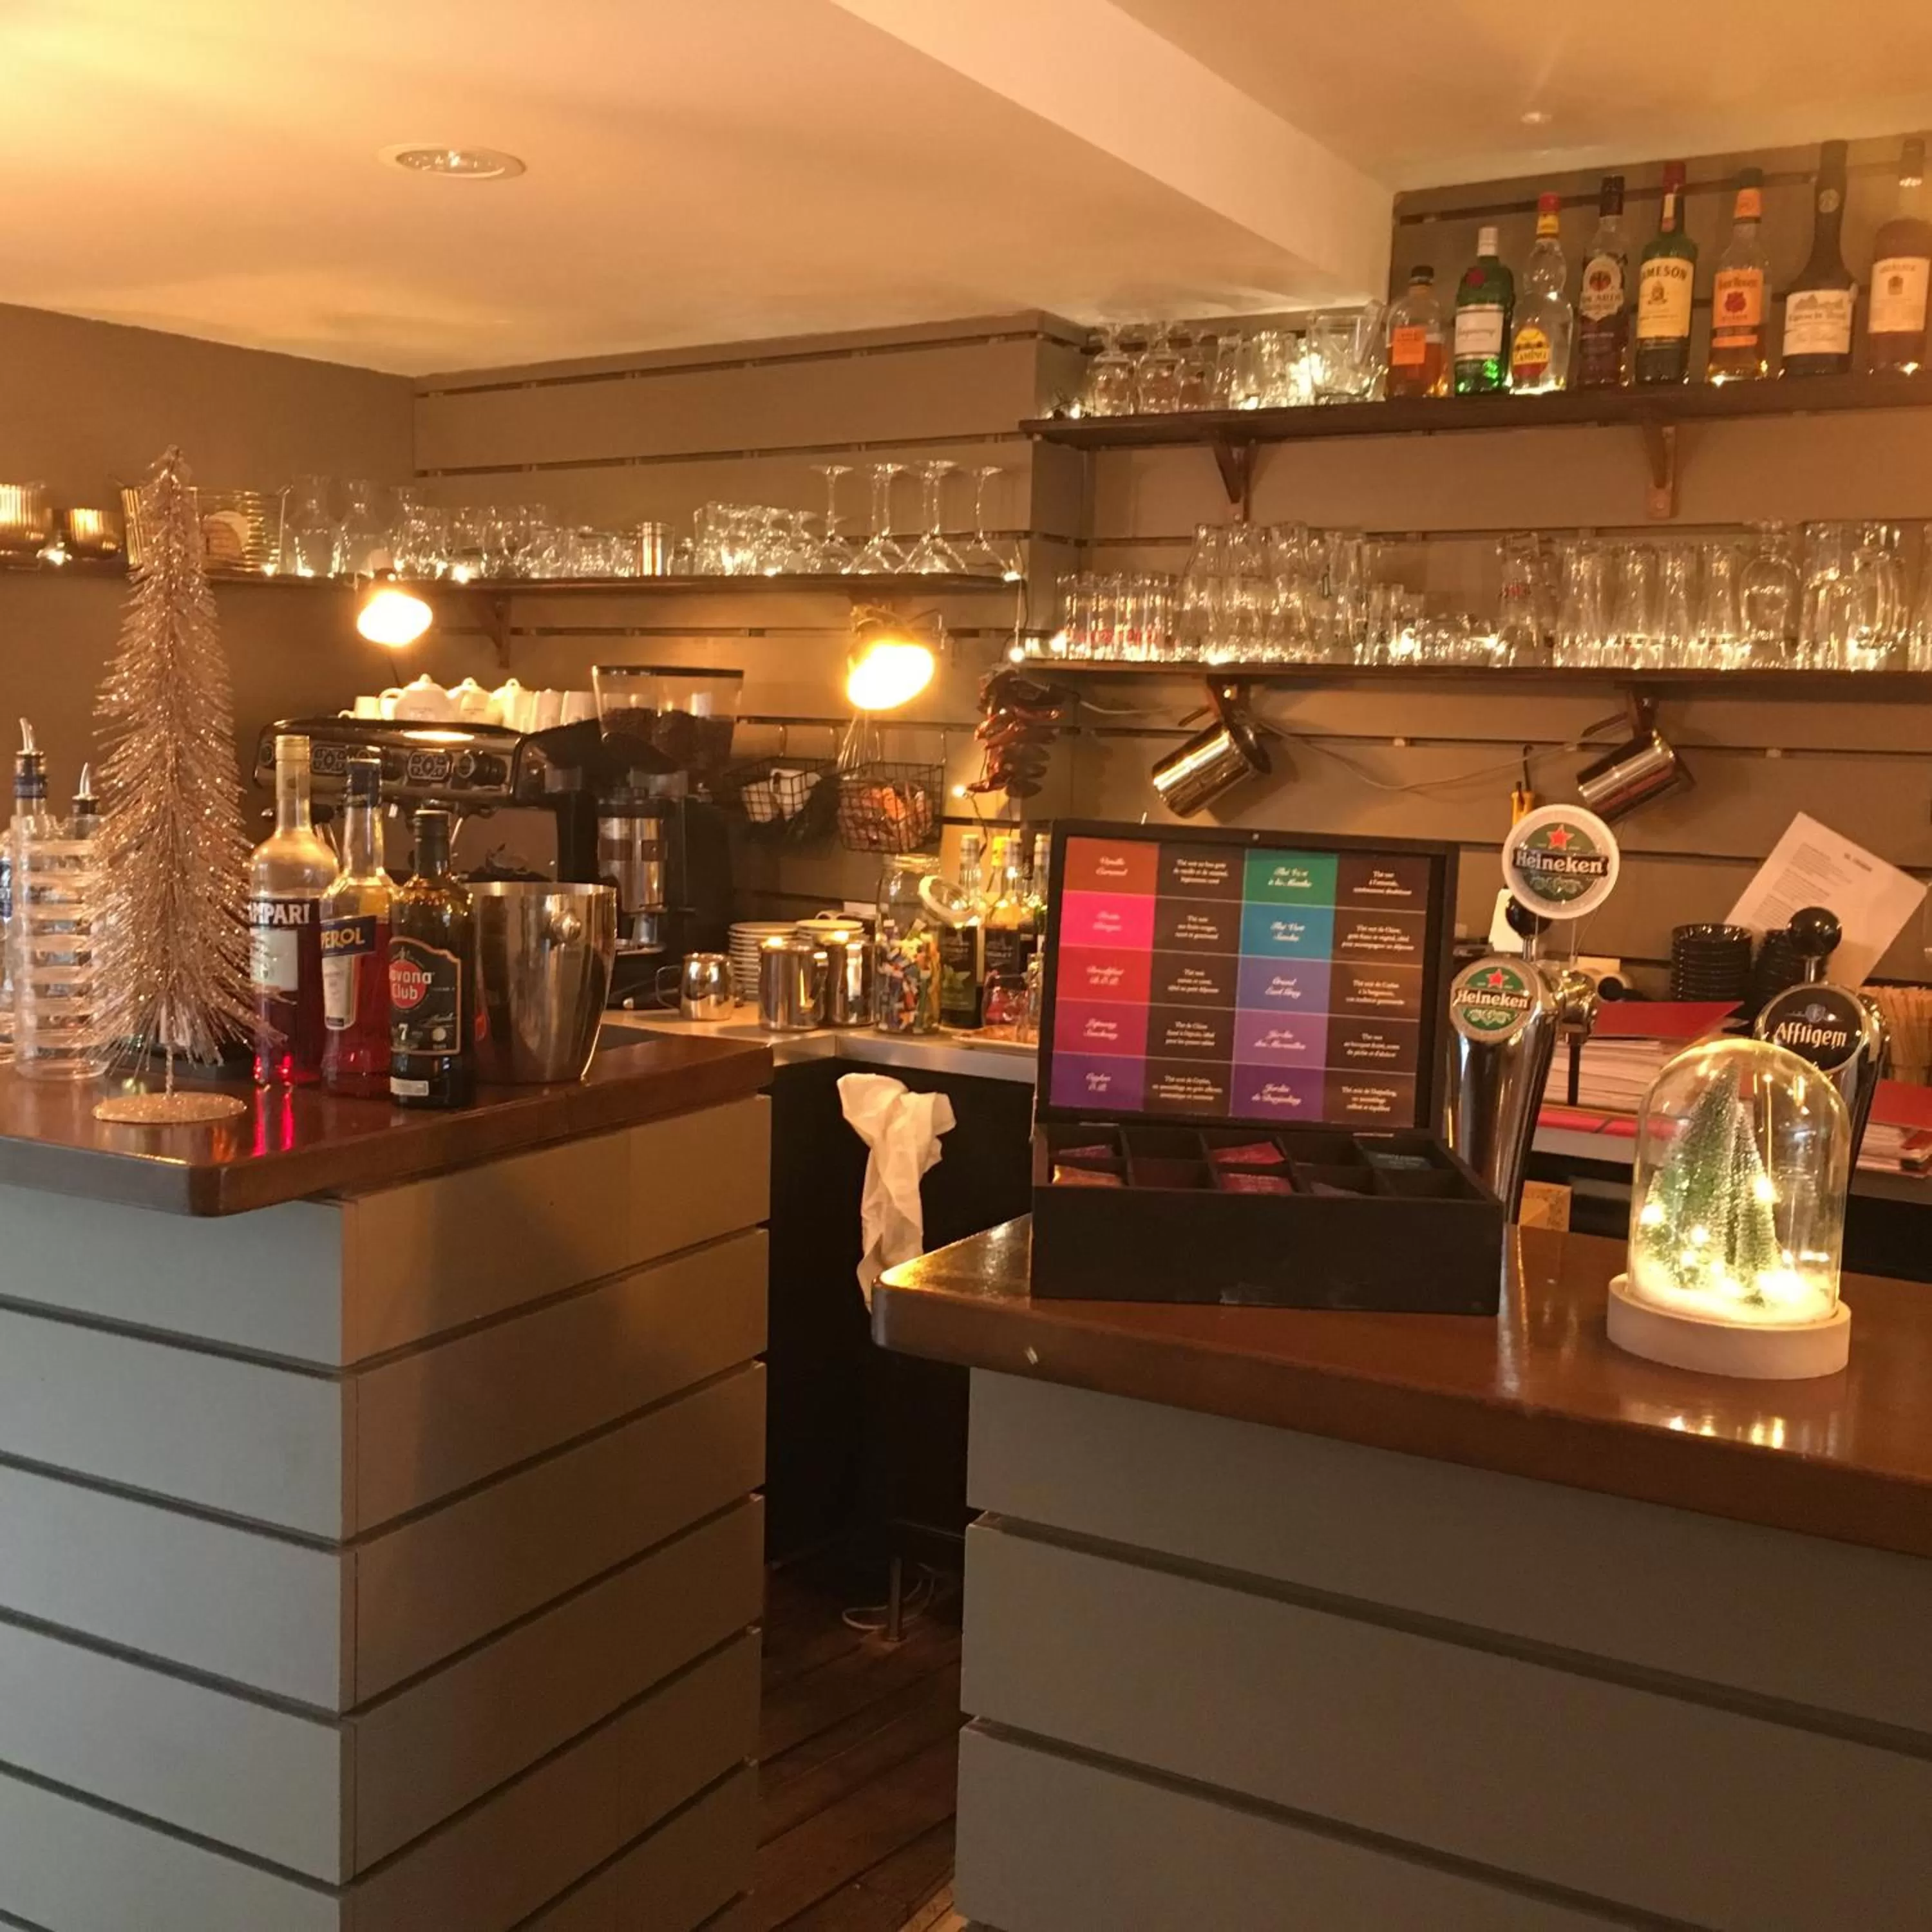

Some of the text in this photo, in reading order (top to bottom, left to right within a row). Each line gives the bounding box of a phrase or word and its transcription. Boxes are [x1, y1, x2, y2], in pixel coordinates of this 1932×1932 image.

[1516, 848, 1603, 875] Heineken
[1457, 989, 1529, 1009] Heineken
[398, 1023, 409, 1041] 7
[1774, 1021, 1848, 1050] Affligem
